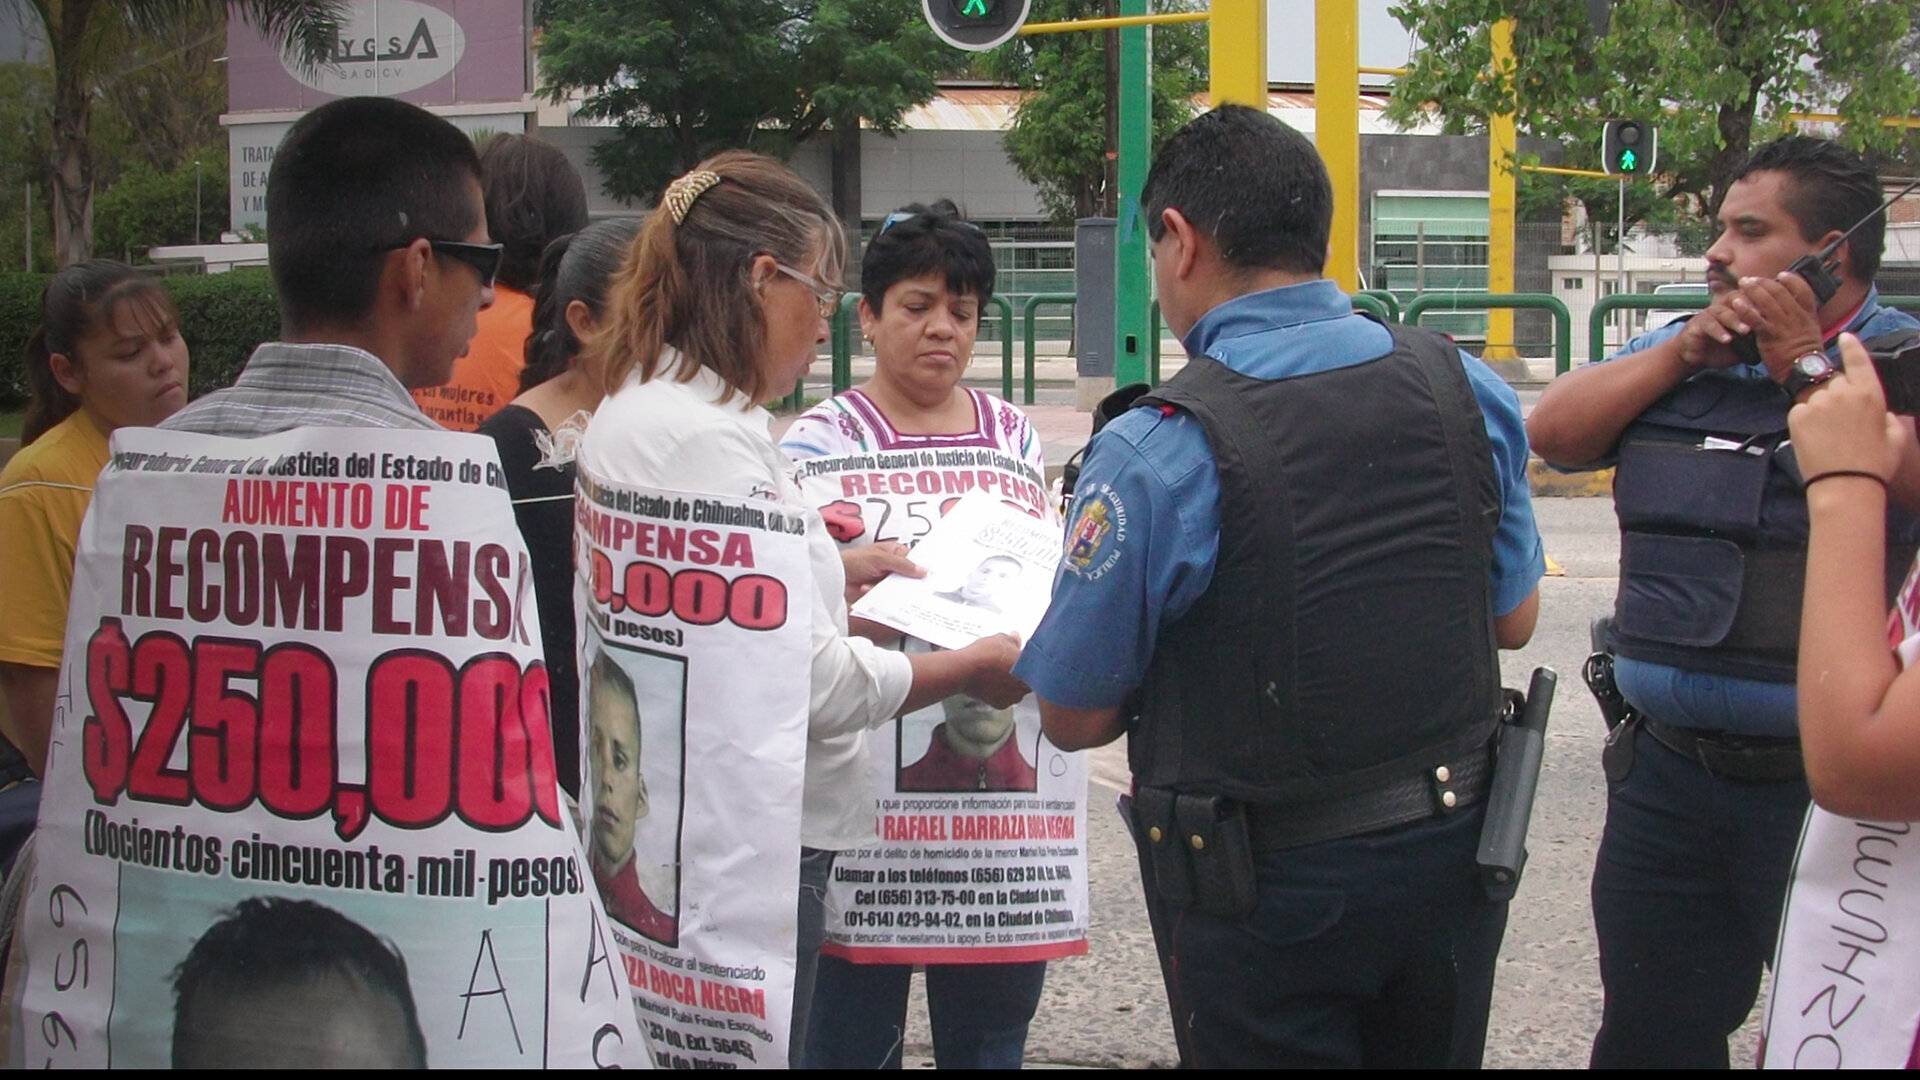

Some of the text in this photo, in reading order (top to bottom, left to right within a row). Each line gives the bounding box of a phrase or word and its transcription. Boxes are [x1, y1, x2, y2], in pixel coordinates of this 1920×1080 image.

[242, 146, 275, 163] TRATA
[242, 171, 257, 188] DE
[242, 195, 249, 212] Y
[440, 384, 495, 406] mujeres
[190, 455, 252, 474] General
[268, 451, 340, 478] Justicia
[345, 452, 375, 479] del
[381, 453, 453, 482] Estado
[459, 458, 482, 485] de
[806, 454, 876, 477] Procuraduria
[877, 450, 919, 470] General
[920, 450, 934, 467] de
[935, 449, 975, 467] Justicia
[976, 449, 992, 467] del
[992, 450, 1016, 473] Estado
[840, 469, 1045, 516] RECOMPENSA
[221, 479, 431, 532] AUMENTO DE
[616, 488, 632, 512] del
[633, 491, 671, 519] Estado
[673, 497, 690, 522] de
[693, 498, 767, 532] Chihuahua,
[1100, 483, 1127, 542] SEGURIDAD
[614, 620, 684, 648] pesos)
[882, 800, 900, 811] que
[903, 798, 959, 812] proporcione
[961, 796, 1013, 810] información
[883, 814, 948, 842] RAFAEL
[951, 814, 1026, 842] BARRAZA
[857, 848, 872, 860] por
[873, 847, 882, 859] el
[884, 847, 908, 859] delito
[910, 847, 921, 859] de
[923, 847, 970, 859] homicidio
[971, 847, 983, 859] de
[984, 847, 993, 859] la
[994, 848, 1018, 858] menor
[835, 866, 875, 883] Llamar
[877, 870, 886, 883] a
[888, 867, 907, 883] los
[909, 866, 969, 884] teléfonos
[971, 866, 1005, 883] (656)
[1006, 866, 1025, 883] 629
[855, 888, 876, 906] Cel
[878, 888, 912, 906] (656)
[914, 888, 976, 906] 313-75-00
[978, 890, 994, 906] en
[996, 889, 1007, 906] la
[1009, 887, 1040, 905] Ciudad
[844, 910, 894, 928] (01-614)
[896, 911, 964, 929] 429-94-02,
[965, 913, 981, 928] en
[983, 911, 995, 928] la
[998, 910, 1033, 928] Ciudad
[1034, 909, 1044, 925] de
[896, 934, 946, 944] necesitamos
[948, 933, 956, 944] tu
[985, 931, 996, 944] En
[997, 932, 1014, 944] todo
[630, 939, 649, 956] para
[648, 944, 684, 970] localizar
[686, 956, 697, 971] al
[698, 961, 766, 982] sentenciado
[457, 928, 524, 1056] A
[649, 963, 698, 1008] BOCA
[700, 978, 767, 1021] NEGRA
[650, 1021, 665, 1042] 33
[695, 1014, 726, 1031] Fraire
